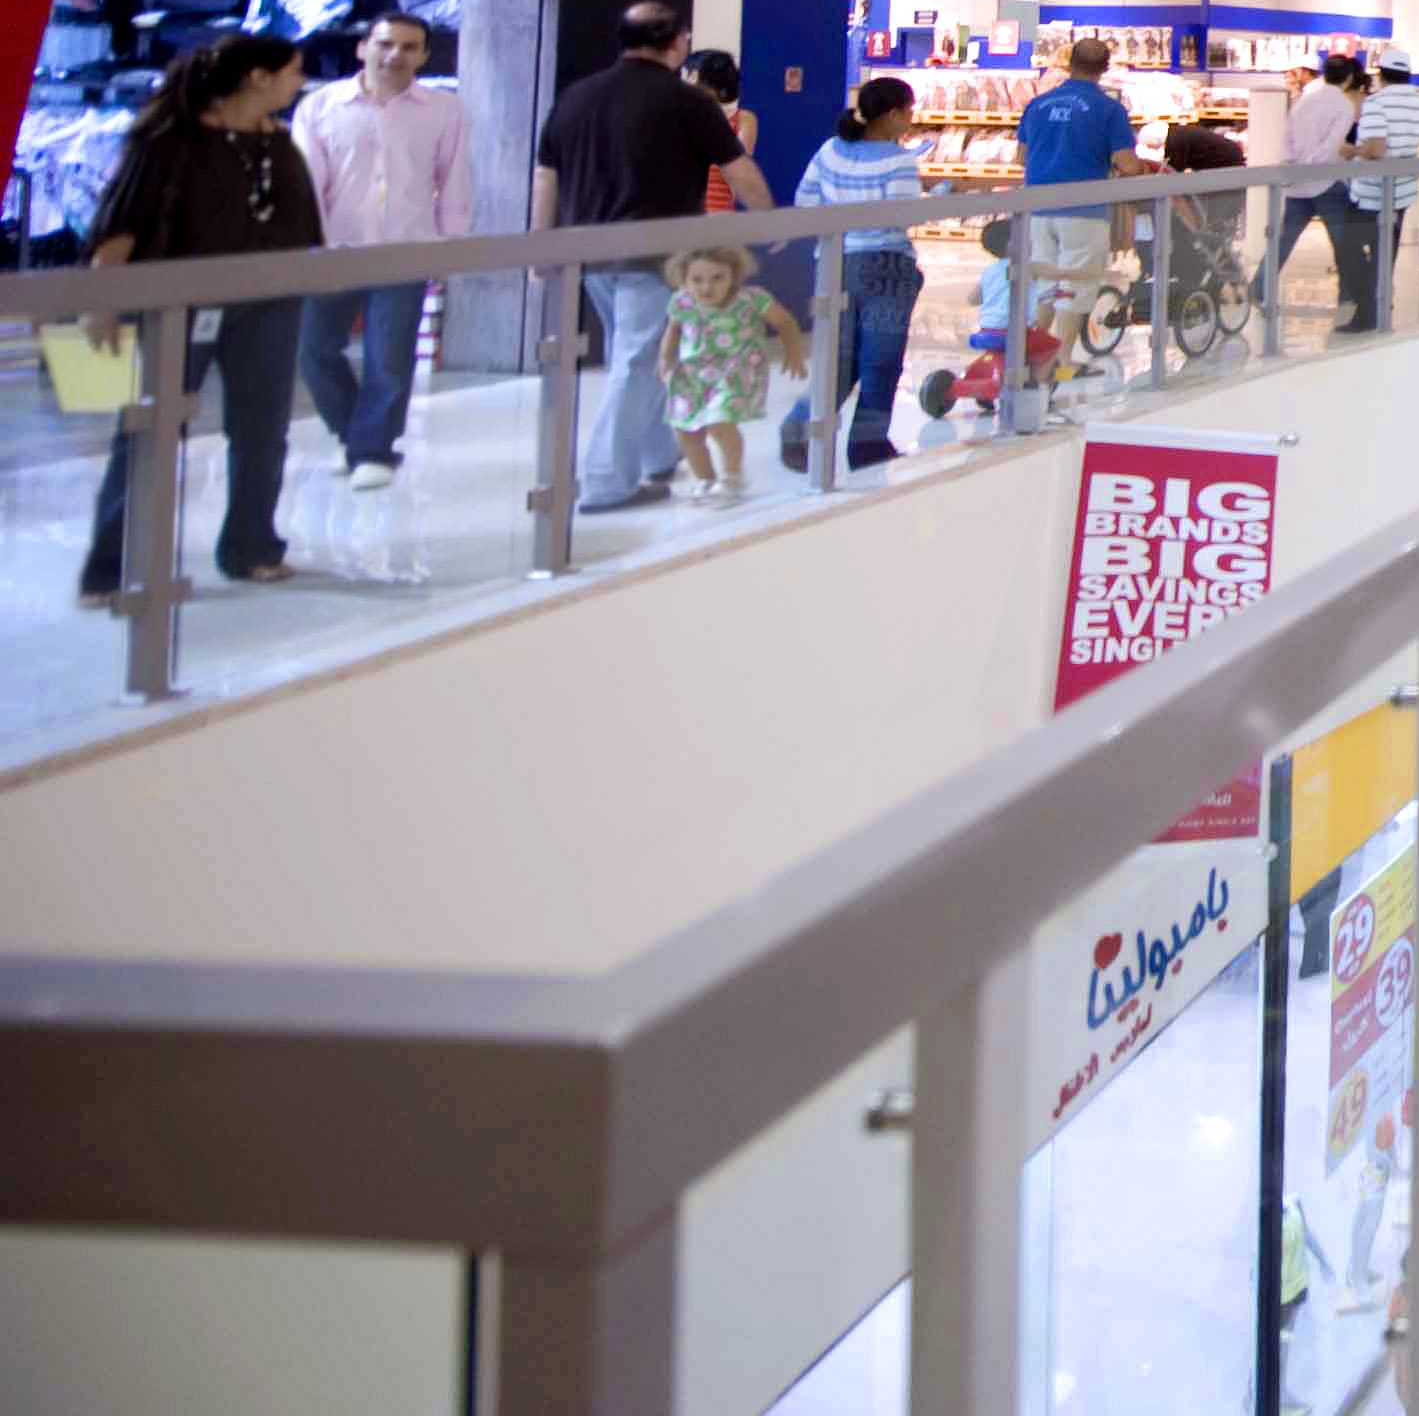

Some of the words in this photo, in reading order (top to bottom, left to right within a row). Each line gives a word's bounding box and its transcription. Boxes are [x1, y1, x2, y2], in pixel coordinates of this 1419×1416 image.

[1087, 473, 1271, 522] BIG
[1084, 512, 1269, 545] BRANDS
[1080, 536, 1268, 584] BIG
[1077, 575, 1264, 607] SAVINGS
[1072, 599, 1240, 641] EVER
[1335, 901, 1375, 980] 29
